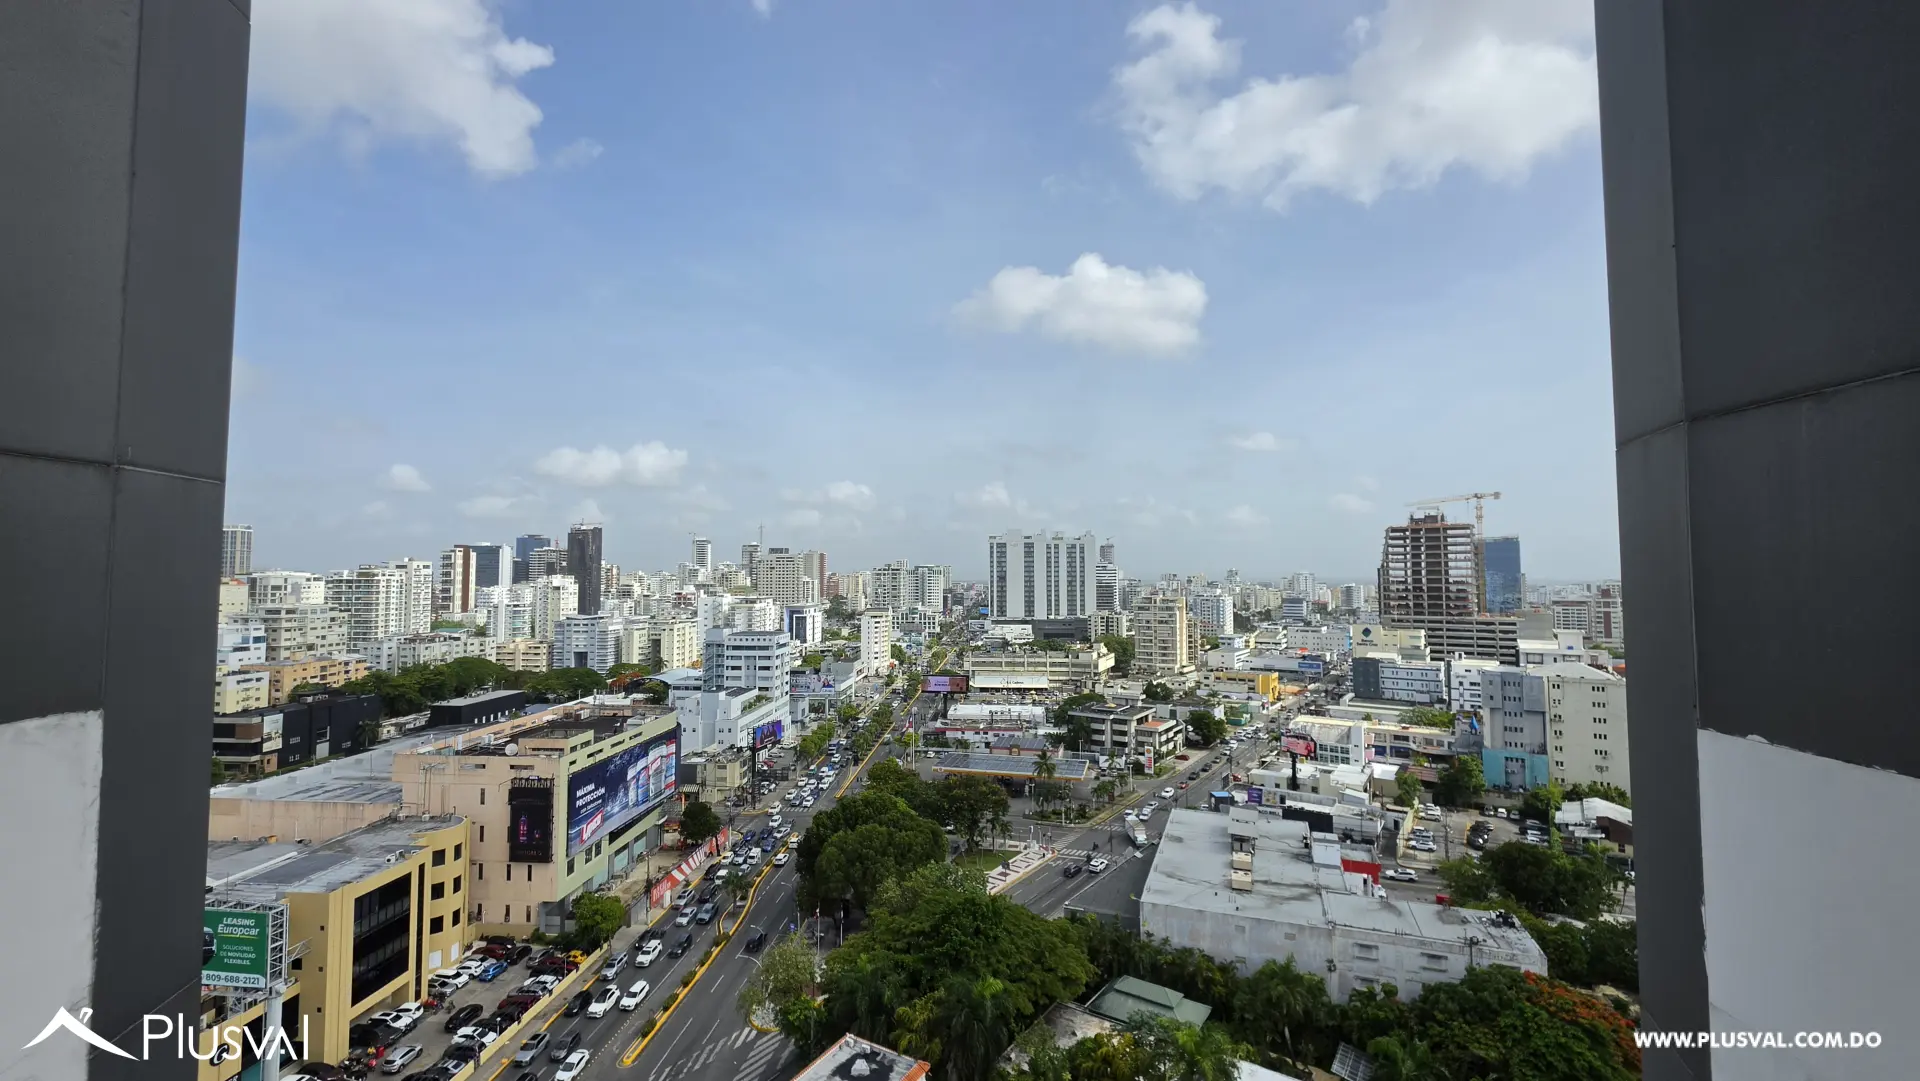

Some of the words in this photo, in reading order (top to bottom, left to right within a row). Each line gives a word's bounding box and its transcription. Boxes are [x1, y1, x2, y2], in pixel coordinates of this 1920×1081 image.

[576, 783, 595, 798] MÁXIMA
[576, 787, 606, 808] PROTECCIÓN
[223, 917, 256, 926] LEASING
[217, 924, 260, 937] Europcar
[222, 944, 254, 952] SOLUCIONES
[205, 973, 260, 985] 809-688-2121
